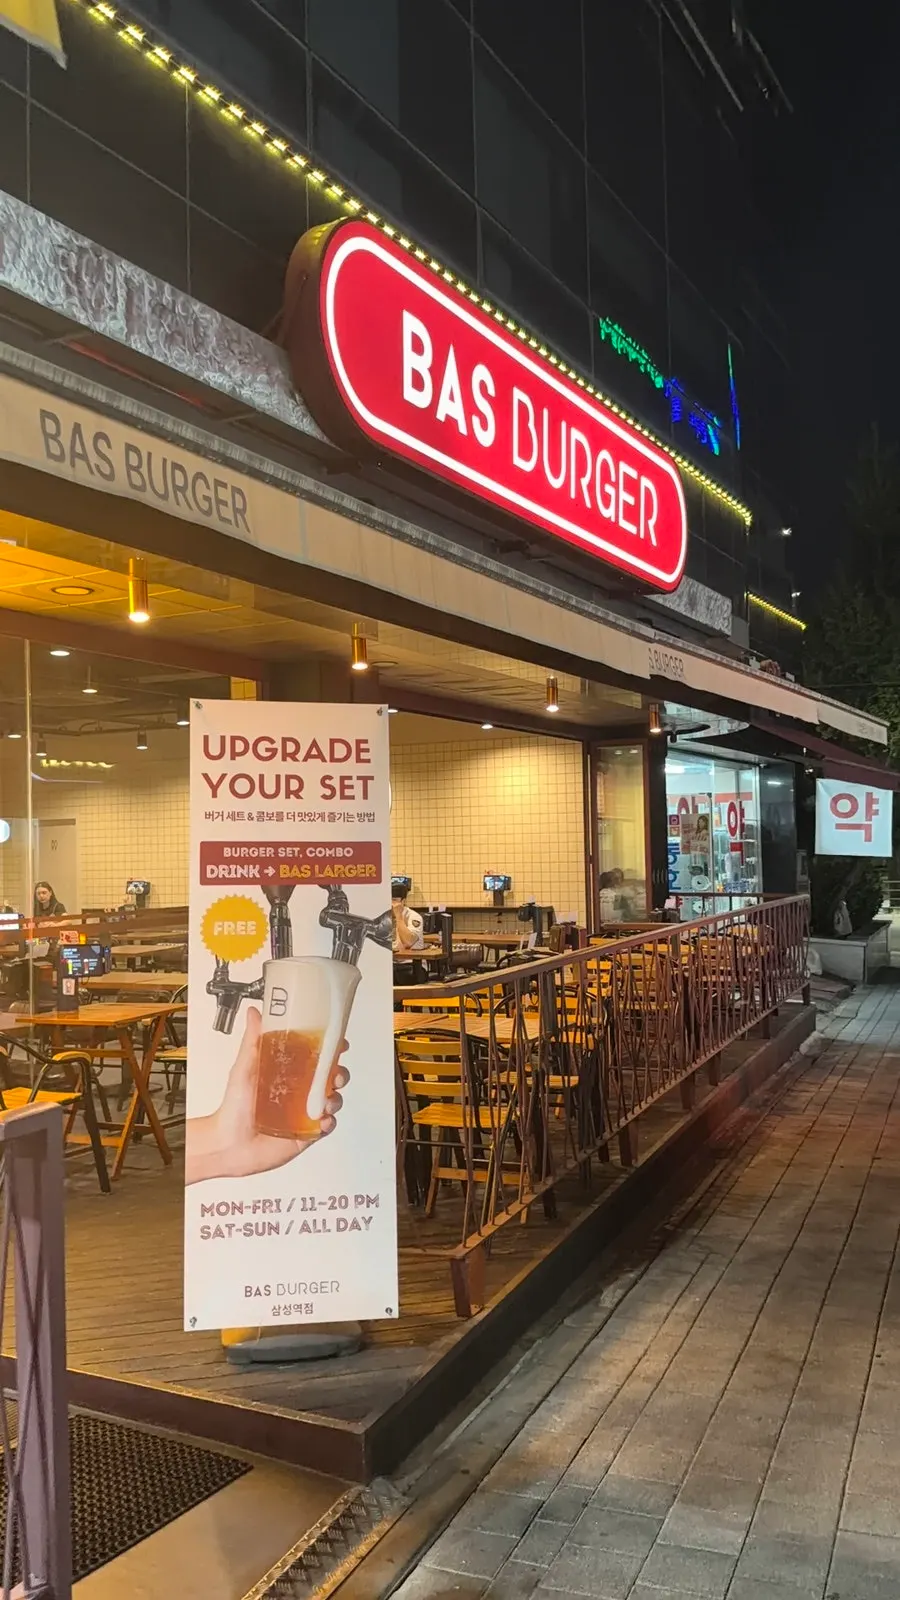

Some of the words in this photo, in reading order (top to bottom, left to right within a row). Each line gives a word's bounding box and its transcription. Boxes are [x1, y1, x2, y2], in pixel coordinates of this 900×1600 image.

[402, 309, 496, 447] BAS
[512, 386, 658, 546] BURGER
[39, 408, 115, 482] BAS
[124, 442, 251, 533] BURGER
[203, 735, 371, 763] UPGRADE
[201, 773, 304, 799] YOUR
[320, 775, 374, 800] SET
[204, 811, 224, 822] 버거
[226, 811, 246, 822] 세트
[247, 813, 254, 821] &
[255, 811, 285, 823] 콤보를
[286, 812, 296, 822] 더
[297, 812, 326, 823] 맛있게
[327, 812, 356, 823] 즐기는
[356, 812, 376, 823] 방법
[829, 791, 880, 842] 약
[223, 847, 275, 858] BURGER
[306, 847, 353, 858] COMBO
[206, 864, 260, 879] DRINK
[279, 864, 311, 878] BAS
[315, 864, 377, 878] LARGER
[213, 921, 257, 936] FREE
[200, 1198, 282, 1218] MON-FRI
[286, 1198, 296, 1213] /
[353, 1194, 380, 1209] PM
[199, 1221, 280, 1240] SAT-SUN
[285, 1220, 294, 1235] /
[299, 1218, 332, 1234] ALL
[335, 1216, 373, 1233] DAY
[244, 1285, 272, 1297] BAS
[276, 1280, 340, 1296] BURGER
[271, 1302, 314, 1316] 삼성역점
